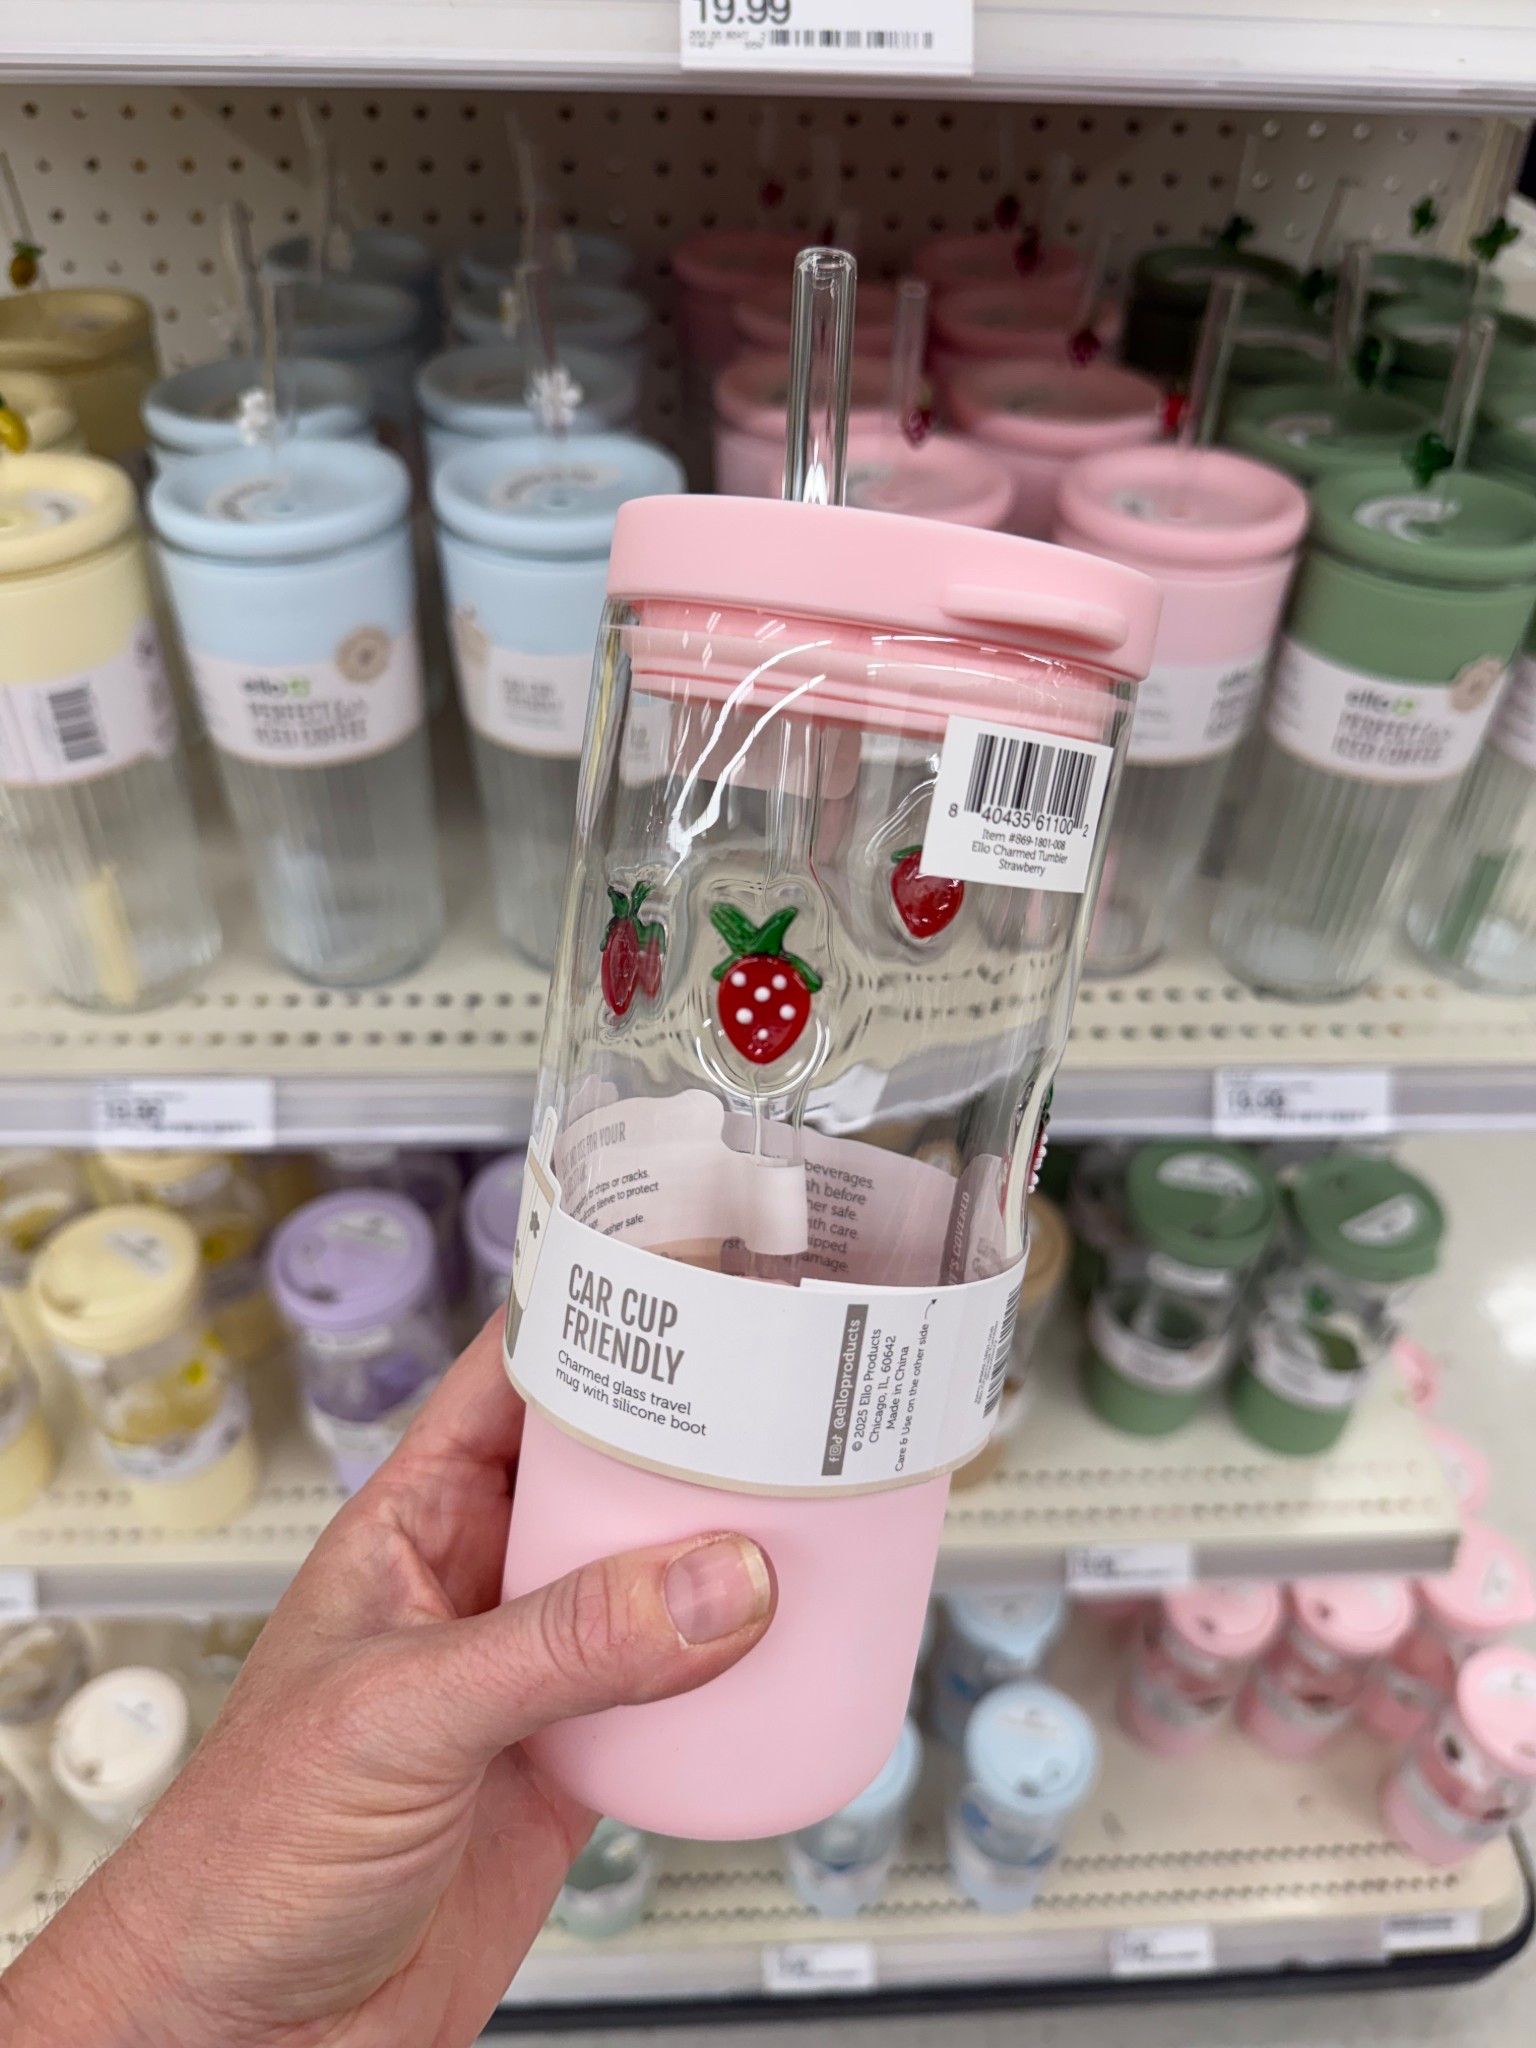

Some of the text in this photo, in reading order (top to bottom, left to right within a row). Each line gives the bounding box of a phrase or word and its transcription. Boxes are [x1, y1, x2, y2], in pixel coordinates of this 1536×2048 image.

[694, 0, 792, 25] 19.99
[948, 803, 1089, 838] 8 40435 61100 2
[982, 828, 1006, 843] Item
[971, 840, 1069, 865] Ello Charmed Tumbler
[998, 858, 1047, 877] Strawberry
[600, 1121, 626, 1148] YOUR
[611, 1178, 620, 1188] or
[616, 1190, 625, 1200] to
[626, 1182, 660, 1200] protect
[824, 1182, 867, 1206] before
[952, 1191, 971, 1258] COVERED
[568, 1263, 679, 1338] CAR CUP
[562, 1303, 685, 1385] FRIENDLY
[919, 1323, 930, 1346] side
[863, 1328, 882, 1382] Products
[913, 1348, 925, 1377] other
[558, 1350, 692, 1416] Charmed glass travel
[833, 1319, 861, 1430] @elloproducts
[909, 1378, 920, 1397] the
[859, 1384, 873, 1406] Ello
[868, 1392, 888, 1443] Chicago,
[881, 1335, 897, 1373] 60642
[886, 1346, 910, 1430] Made in China
[556, 1367, 707, 1437] mug with silicone boot
[907, 1398, 916, 1413] on
[854, 1409, 868, 1439] 2025
[901, 1415, 913, 1435] Use
[894, 1447, 907, 1472] Care
